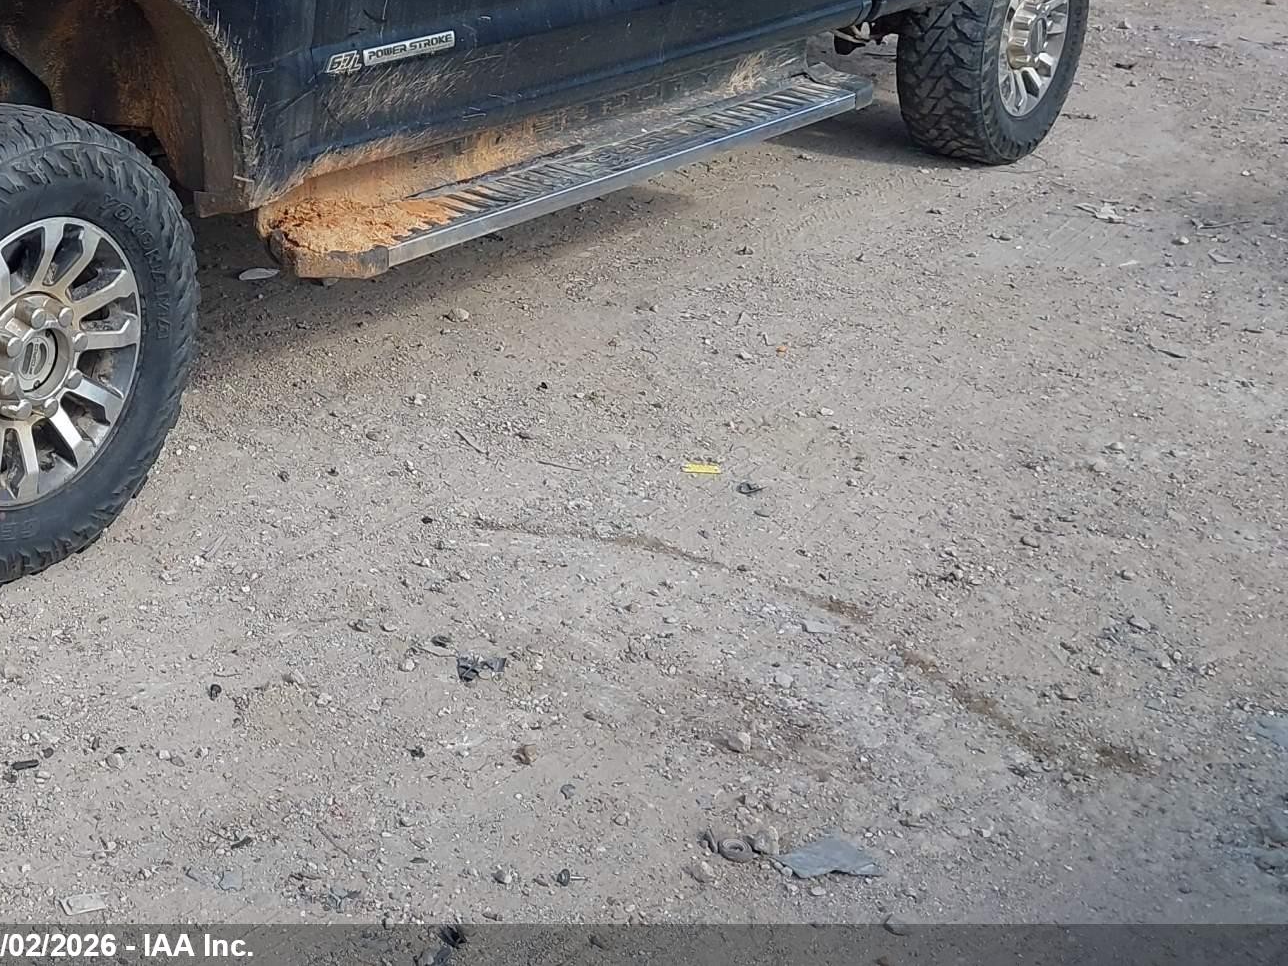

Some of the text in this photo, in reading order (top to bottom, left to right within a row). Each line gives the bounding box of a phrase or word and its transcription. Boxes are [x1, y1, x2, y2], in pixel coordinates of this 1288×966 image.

[367, 44, 408, 61] POWER
[408, 34, 453, 51] STROKE
[98, 192, 171, 340] YOKOHAMA
